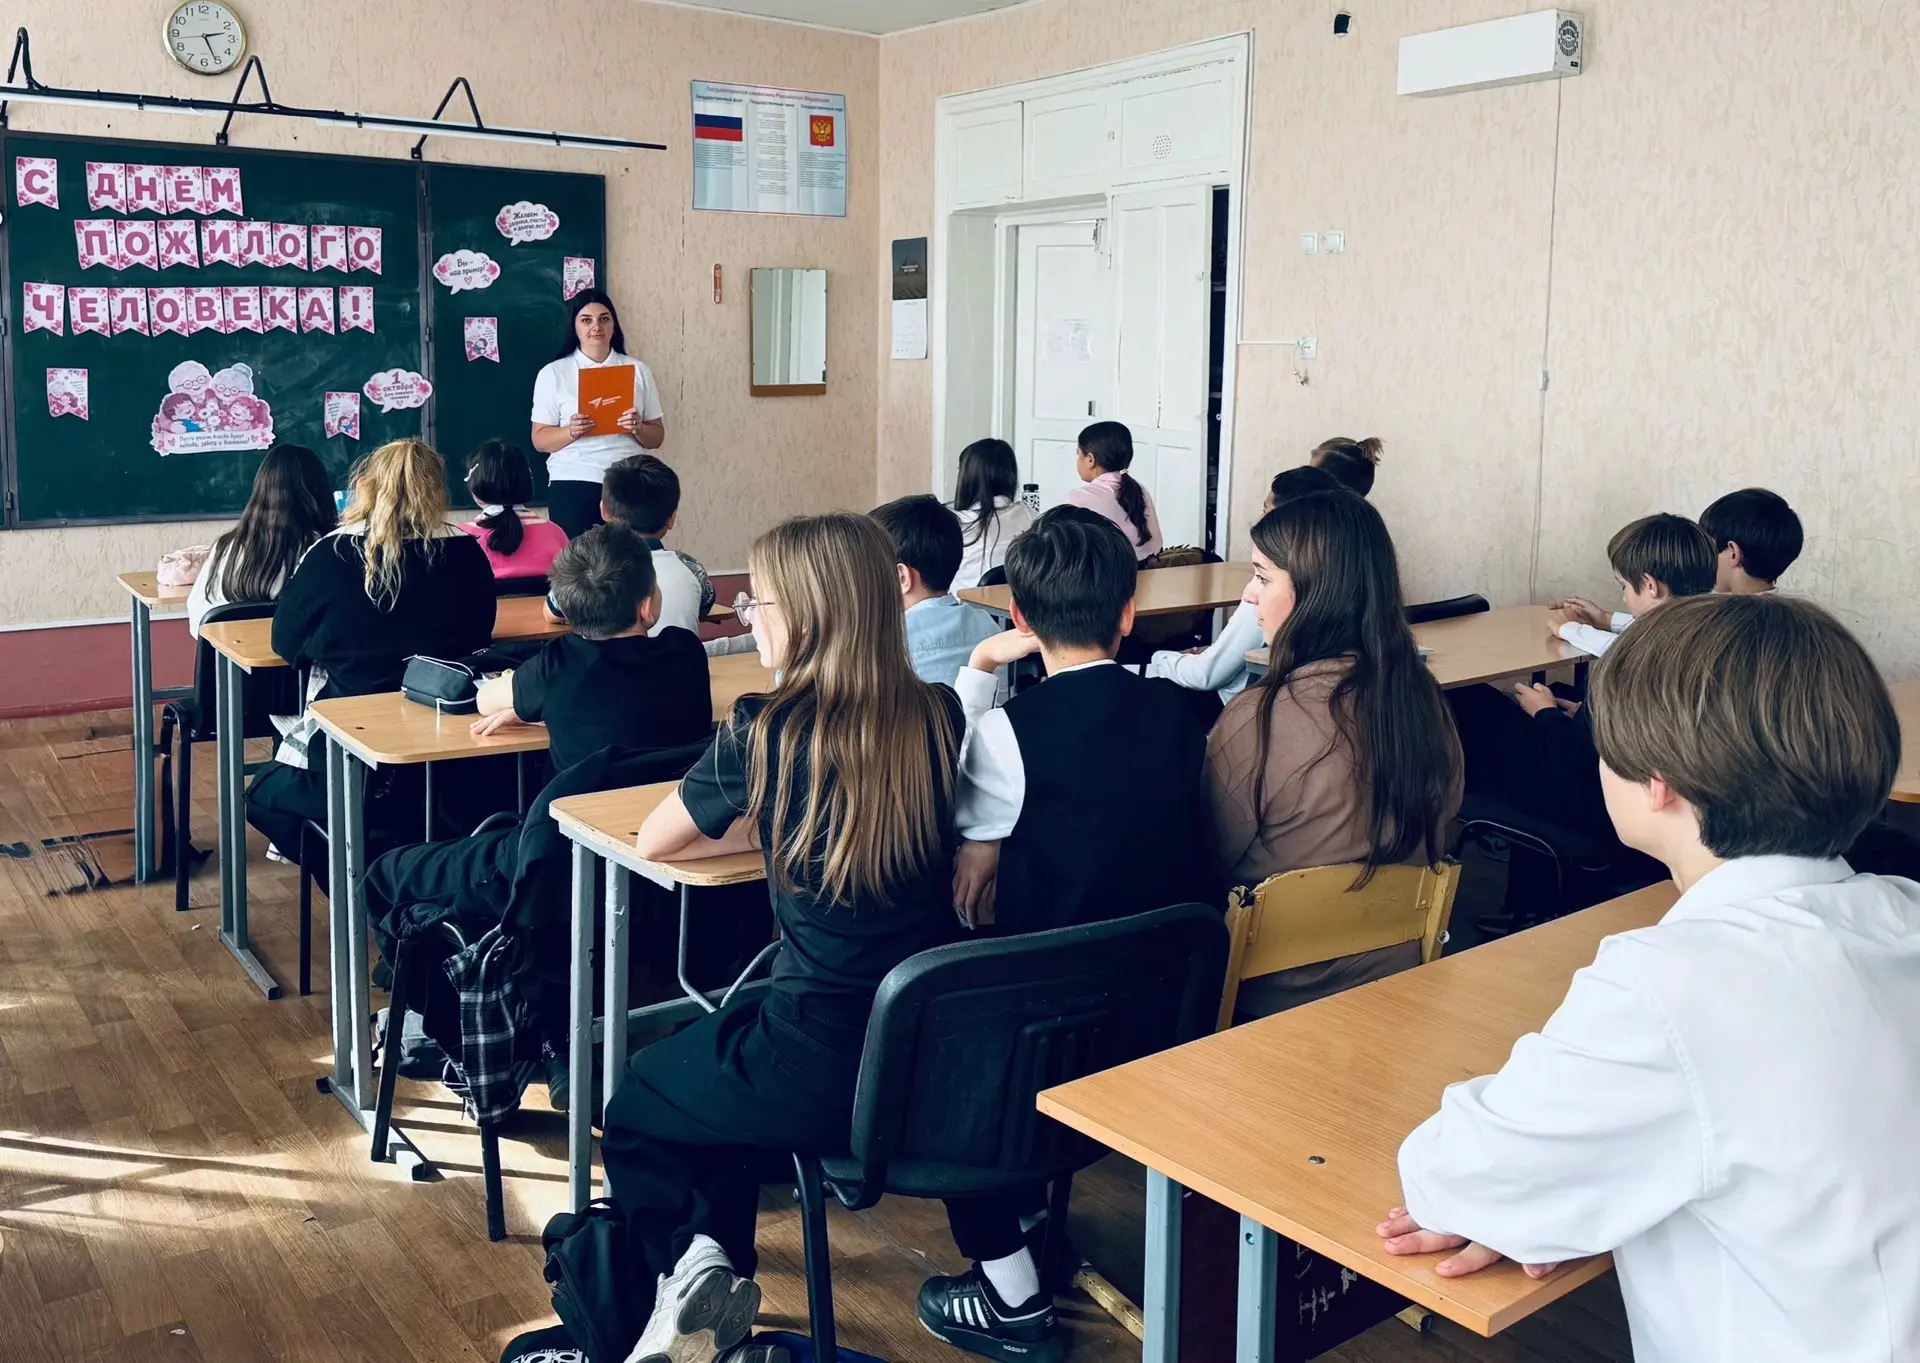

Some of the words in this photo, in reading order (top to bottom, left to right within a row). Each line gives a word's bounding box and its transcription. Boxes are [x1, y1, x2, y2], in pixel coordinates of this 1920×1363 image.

[185, 7, 194, 17] 11
[198, 5, 209, 14] 12
[175, 16, 186, 25] 10
[223, 21, 231, 30] 2
[172, 29, 180, 38] 9
[227, 35, 236, 43] 3
[176, 42, 185, 51] 8
[224, 48, 231, 56] 4
[187, 53, 194, 62] 7
[214, 56, 222, 65] 5
[200, 58, 209, 67] 6
[24, 169, 50, 195] С
[95, 173, 237, 204] ДНЁМ
[84, 230, 375, 261] ПОЖИЛОГО
[456, 258, 468, 267] Вы
[462, 265, 486, 276] пример!
[32, 294, 361, 323] ЧЕЛОВЕКА!
[392, 371, 401, 385] 1
[383, 383, 414, 391] октября
